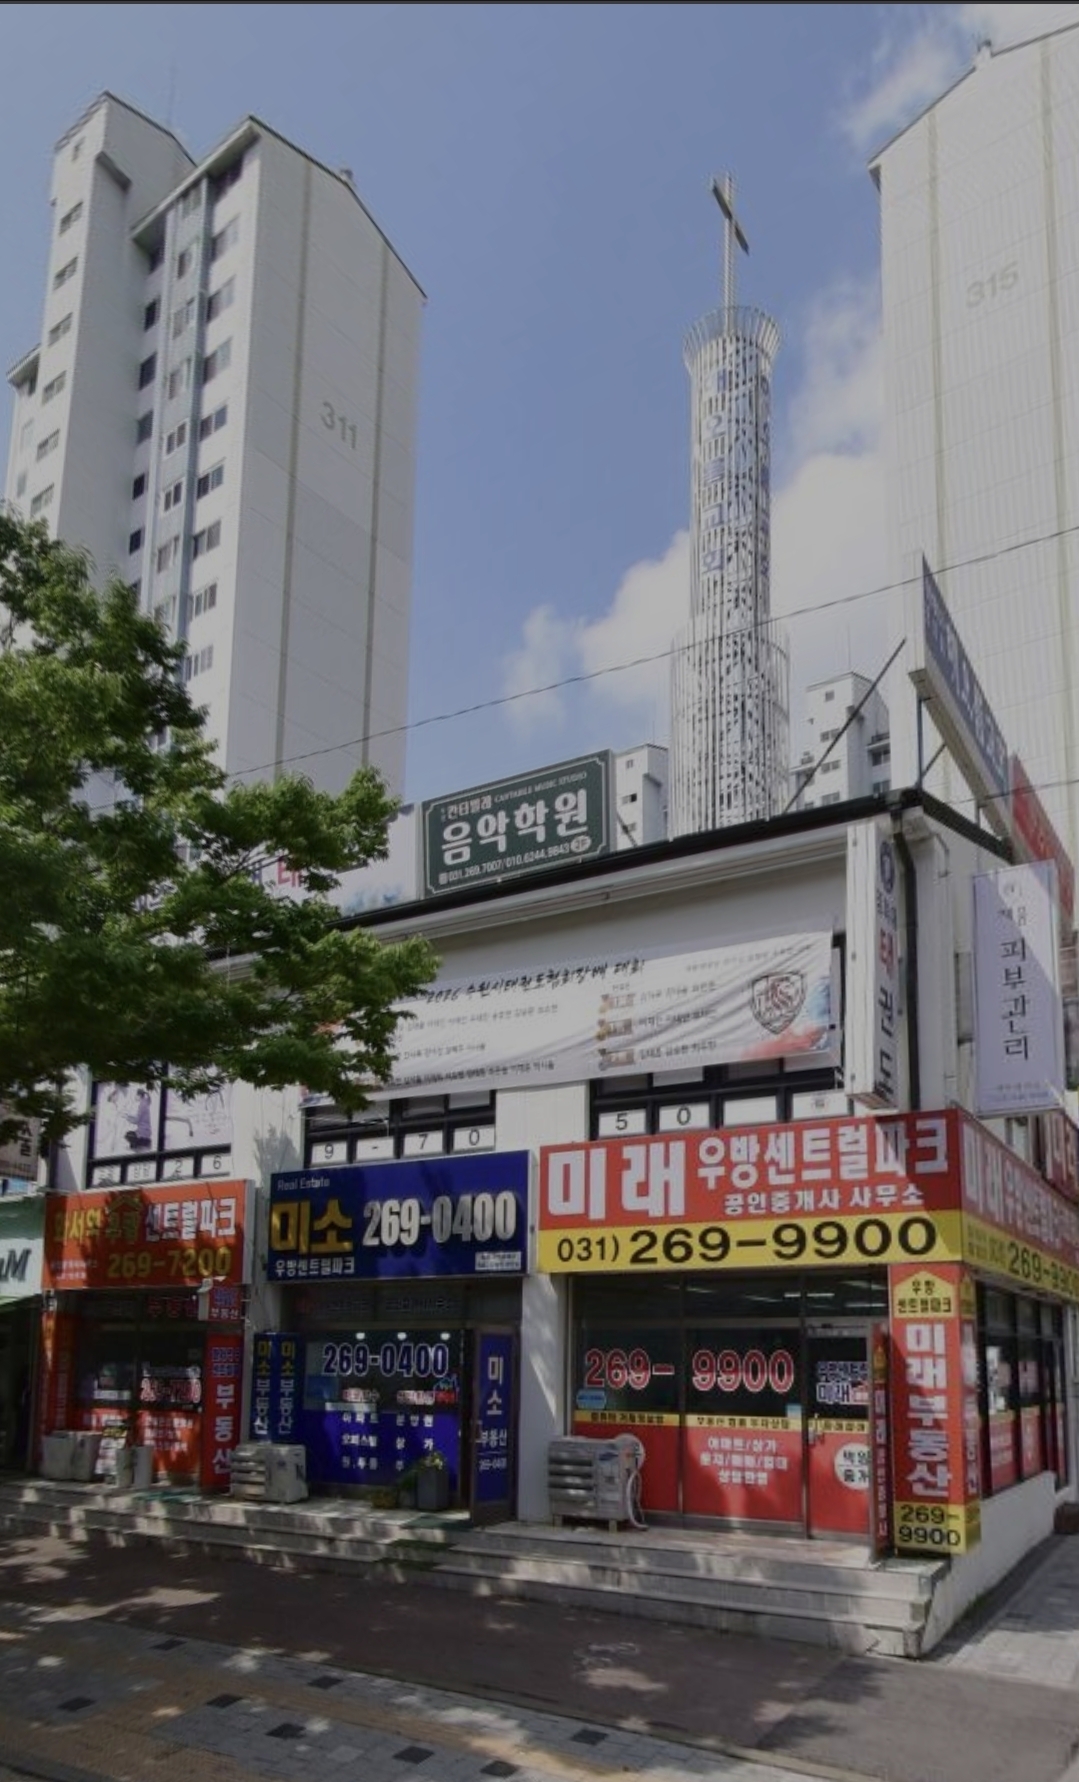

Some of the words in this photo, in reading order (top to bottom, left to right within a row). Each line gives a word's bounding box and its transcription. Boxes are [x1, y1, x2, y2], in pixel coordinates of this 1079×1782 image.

[317, 400, 358, 449] 311
[441, 788, 588, 866] 음악학원
[212, 1154, 222, 1170] 6
[277, 1178, 298, 1191] Real
[547, 1140, 686, 1221] 미래
[697, 1117, 949, 1190] 우방센트럴파크
[145, 1196, 237, 1243] 센트럴파크
[362, 1190, 517, 1247] 269-0400
[724, 1187, 841, 1217] 공인중개사
[850, 1183, 925, 1208] 사무소
[269, 1197, 354, 1256] 미소
[556, 1235, 620, 1264] 031)
[628, 1217, 937, 1266] 269-9900
[106, 1245, 232, 1279] 269-7200
[275, 1255, 355, 1278] 우방센트럴파크
[322, 1342, 450, 1378] 269-0400
[691, 1349, 795, 1394] 9900
[486, 1356, 504, 1416] 미소
[212, 1383, 236, 1475] 부동산
[898, 1525, 961, 1547] 9900
